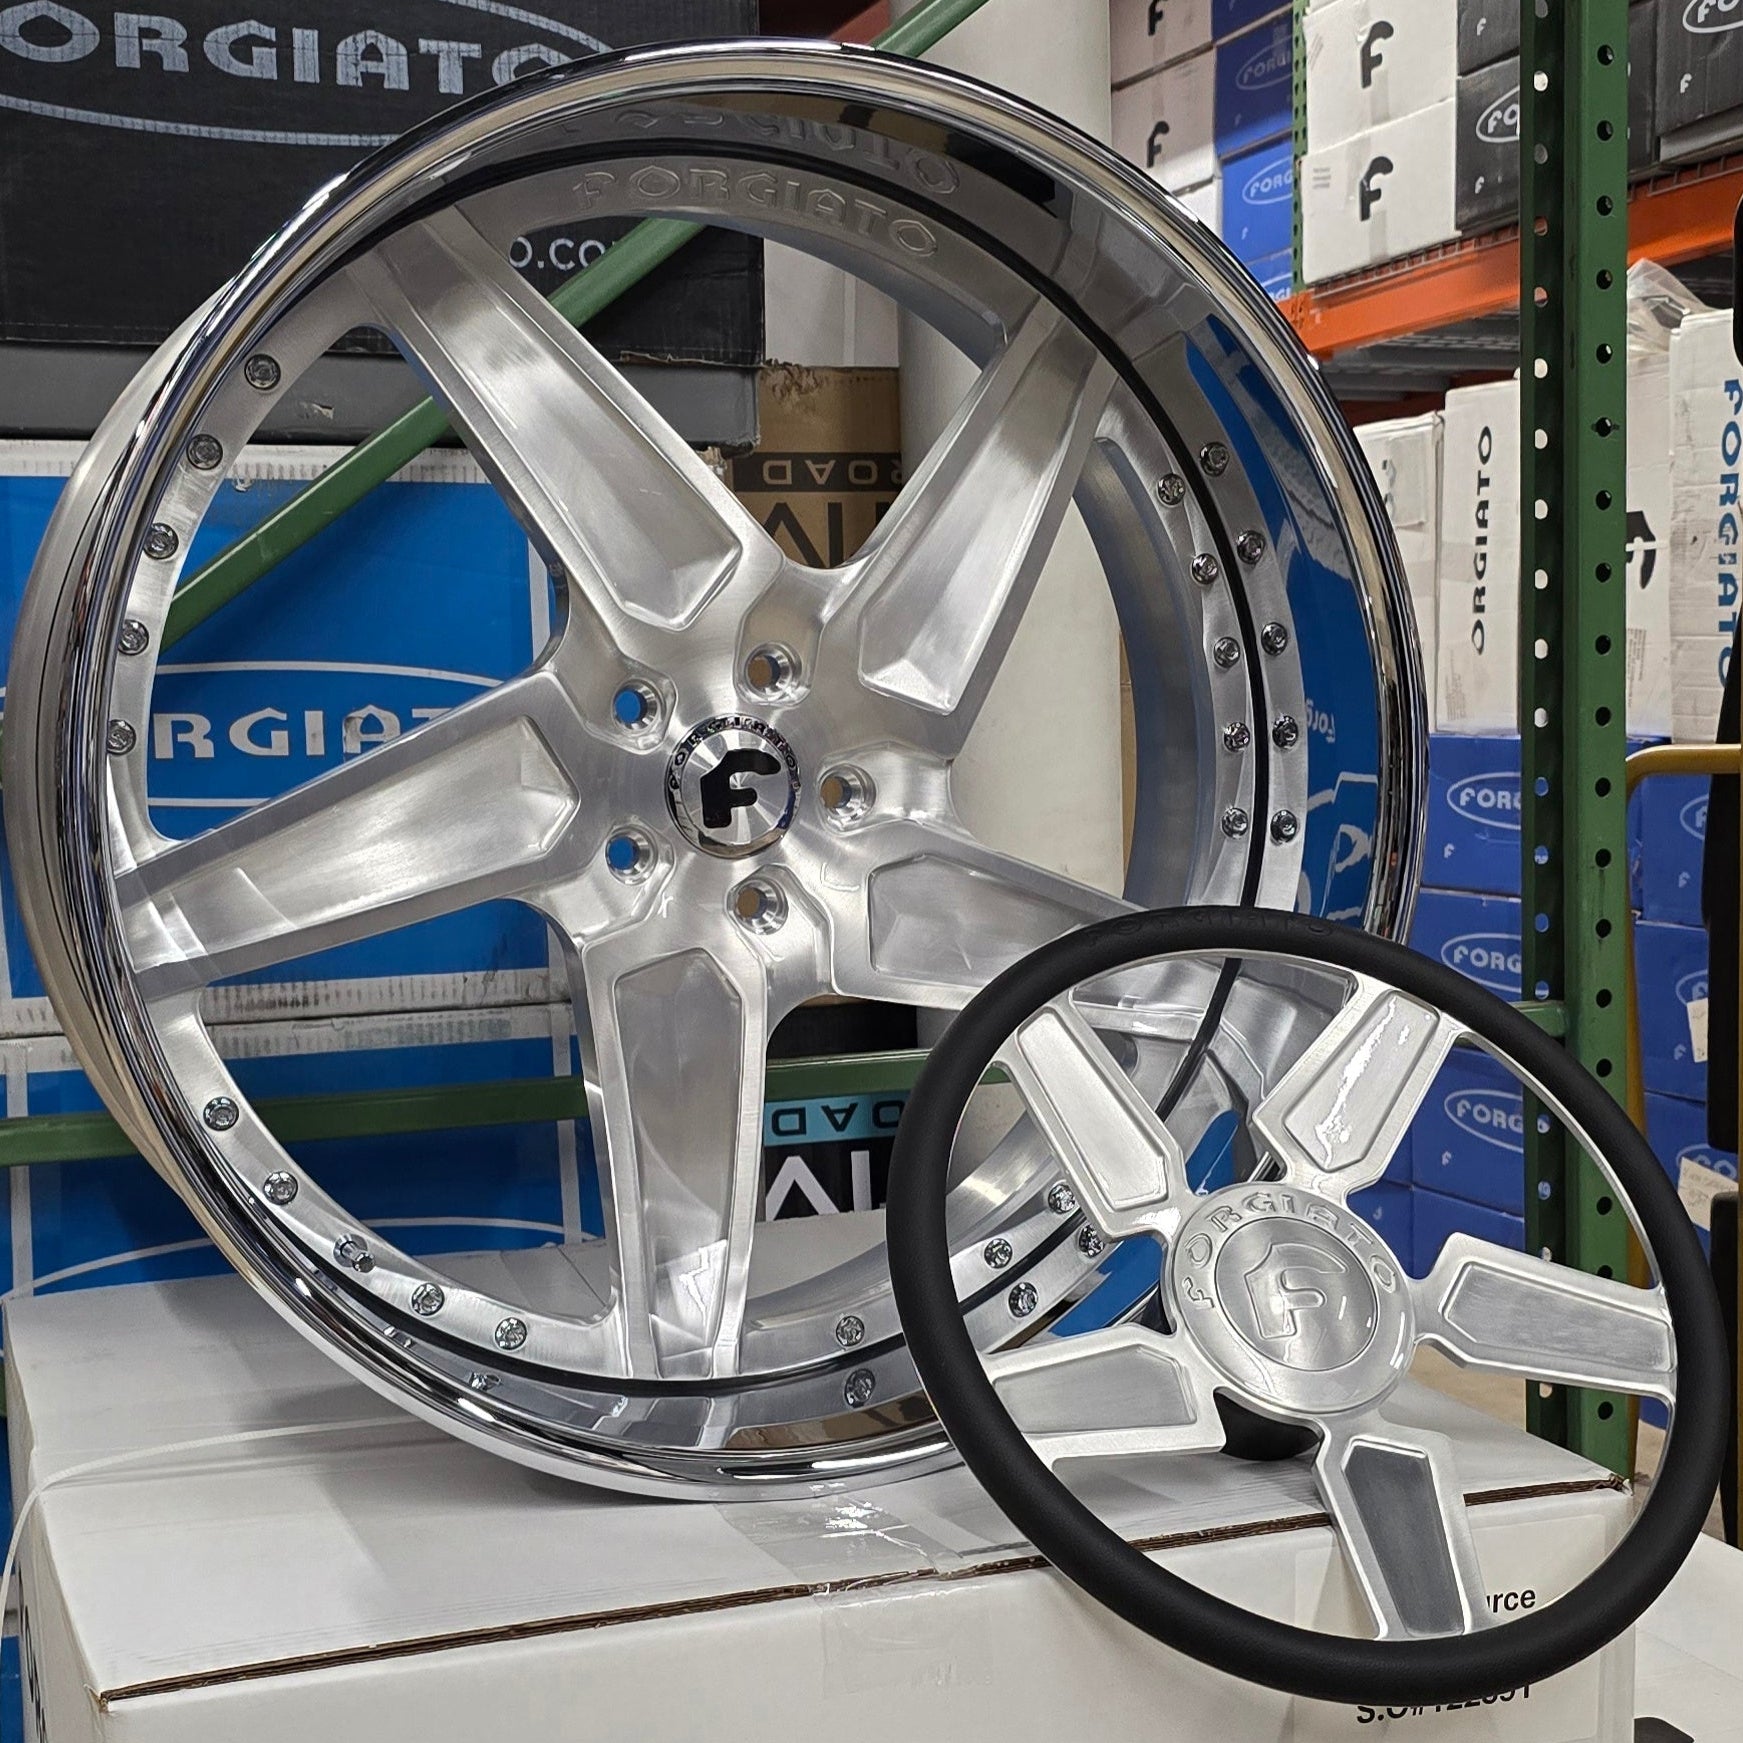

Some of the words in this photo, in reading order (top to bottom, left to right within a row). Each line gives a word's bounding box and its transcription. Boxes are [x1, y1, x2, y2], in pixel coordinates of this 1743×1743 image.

[1487, 103, 1520, 135] FO
[572, 164, 938, 257] FORGIATO
[1471, 425, 1493, 656] ORGIATO
[1181, 1192, 1396, 1310] FORGIATO
[1486, 1589, 1536, 1613] rce
